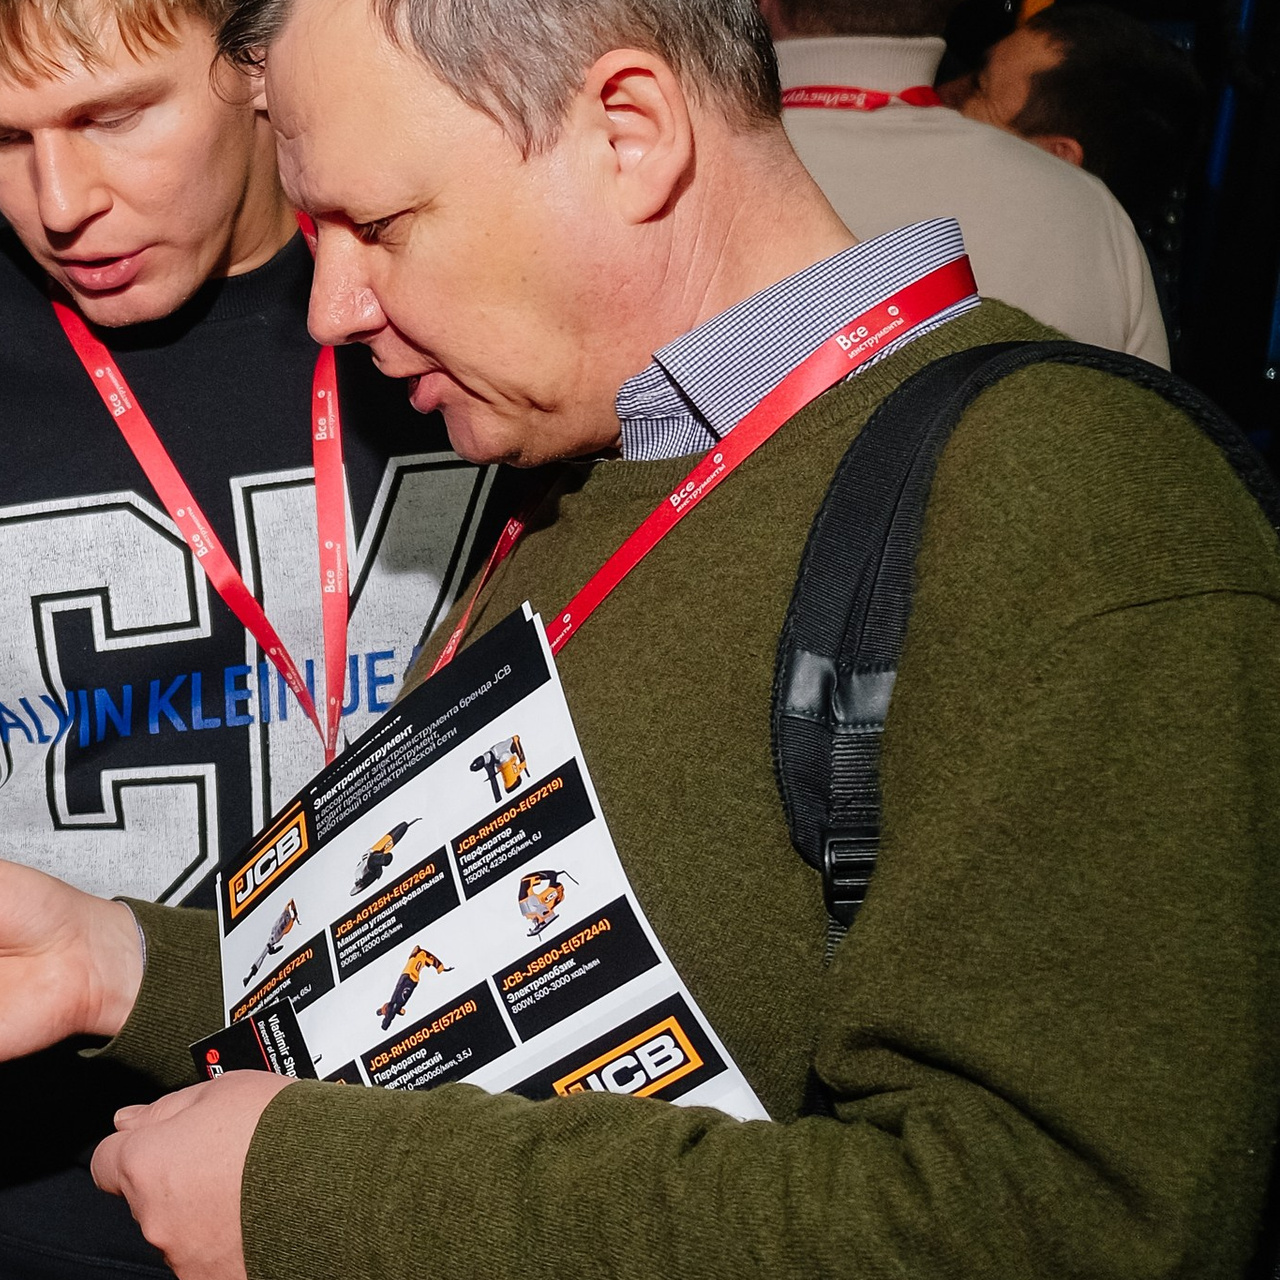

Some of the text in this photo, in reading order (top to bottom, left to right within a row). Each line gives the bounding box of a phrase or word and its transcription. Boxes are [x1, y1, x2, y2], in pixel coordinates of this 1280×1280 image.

[836, 324, 869, 350] Все
[848, 317, 904, 360] инструменты
[109, 393, 126, 417] Все
[315, 418, 327, 440] Все
[670, 480, 696, 507] Все
[677, 463, 726, 512] инструменты
[186, 506, 215, 550] инструменты
[192, 533, 209, 558] Все
[324, 570, 336, 593] Все
[335, 543, 343, 593] инструменты
[320, 774, 371, 817] ассортимент
[371, 706, 459, 775] электроинструмента
[458, 682, 493, 711] бренда
[493, 664, 512, 685] JCB
[313, 724, 414, 810] Электроинструмент
[362, 790, 373, 803] от
[373, 742, 436, 794] электрической
[436, 727, 458, 748] сети
[316, 805, 342, 831] входит
[342, 770, 388, 809] проводной
[456, 777, 563, 854] JCB-RH1500-E(57219)
[236, 827, 300, 903] JCB
[459, 827, 513, 866] Перфоратор
[462, 830, 526, 876] электрический
[465, 865, 490, 885] 1500W,
[489, 856, 508, 874] 4230
[532, 830, 542, 845] 6J
[335, 863, 436, 937] JCB-AG125H-E(57264)
[336, 872, 445, 949] Машина углошлифовальная
[339, 916, 397, 959] электрическая
[361, 939, 381, 956] 12000
[380, 924, 403, 943] об/мин
[502, 918, 611, 991] JCB-JS800-E(57244)
[232, 948, 314, 1022] JCB-DH1700-E(57221)
[506, 957, 576, 1004] Электролобзик
[512, 958, 601, 1014] 800W, 500-3000 ход/мин
[257, 1020, 271, 1046] Director
[266, 1045, 272, 1054] of
[267, 1013, 289, 1057] Vladimir
[369, 1000, 477, 1072] JCB-RH1050-E(57218)
[456, 1047, 472, 1062] 3.5J
[373, 1048, 427, 1084] Перфоратор
